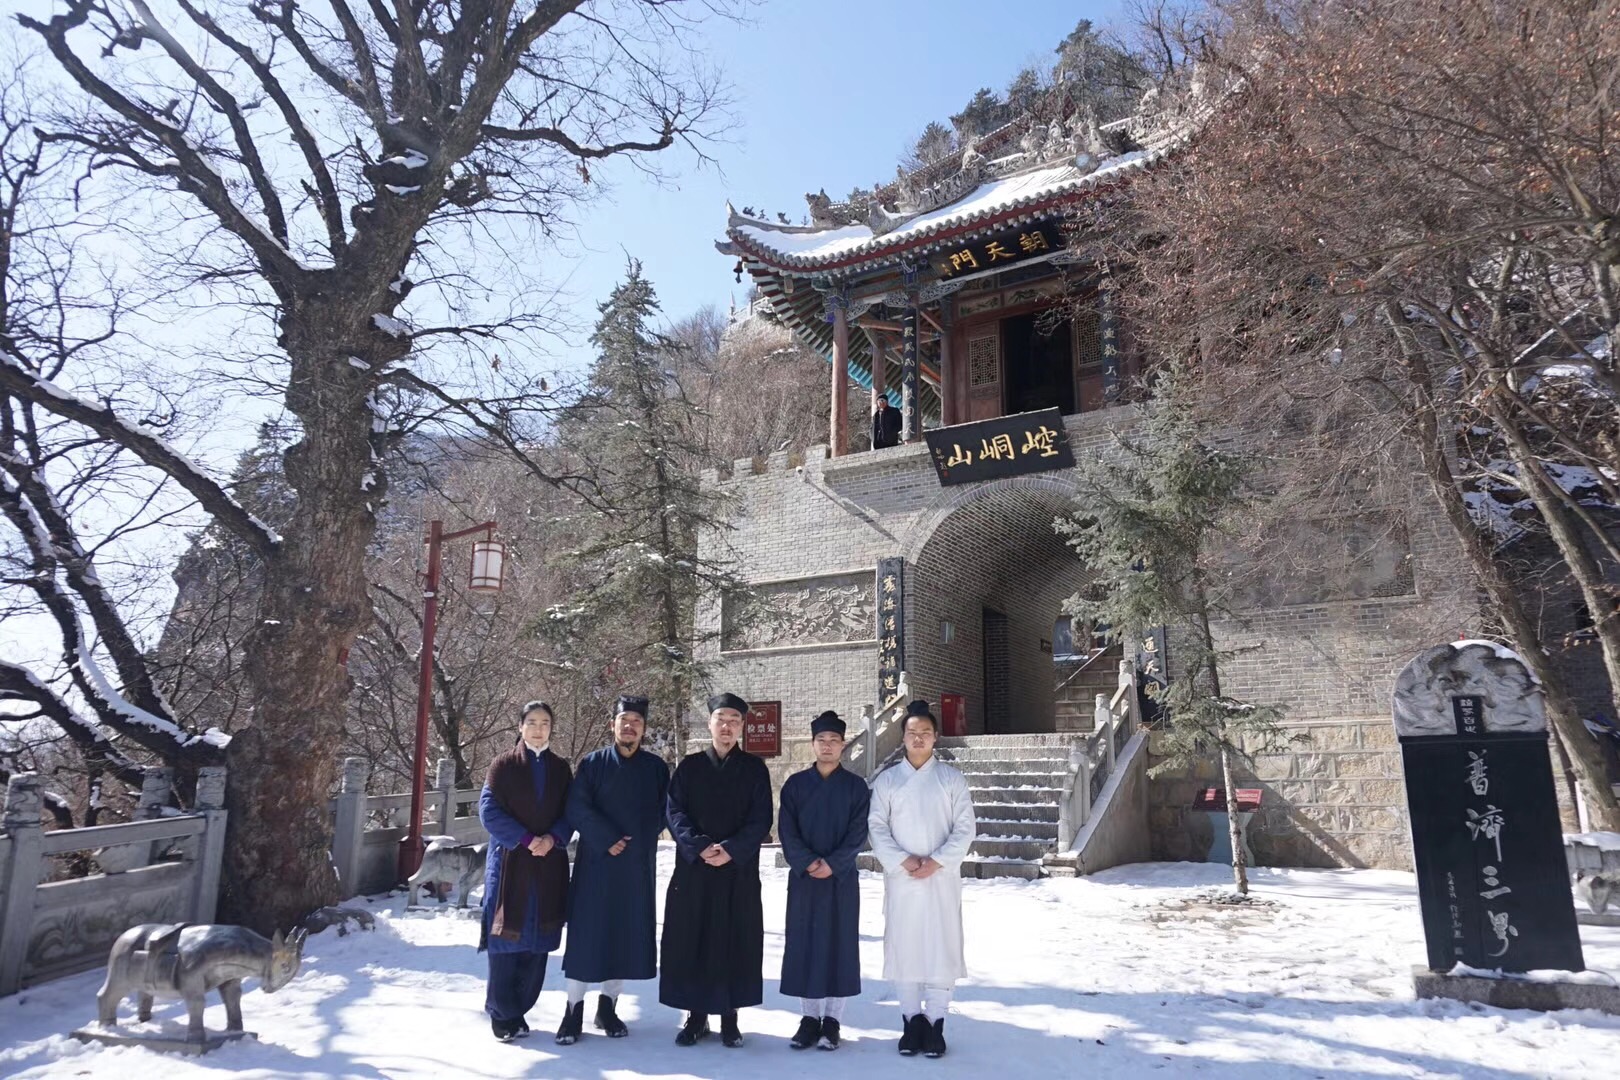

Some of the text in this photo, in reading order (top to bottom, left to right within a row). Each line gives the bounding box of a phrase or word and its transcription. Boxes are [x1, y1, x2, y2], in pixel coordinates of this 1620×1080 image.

[948, 230, 1050, 271] 朝天門
[947, 426, 1058, 468] 崆峒山
[747, 723, 776, 734] 检票处
